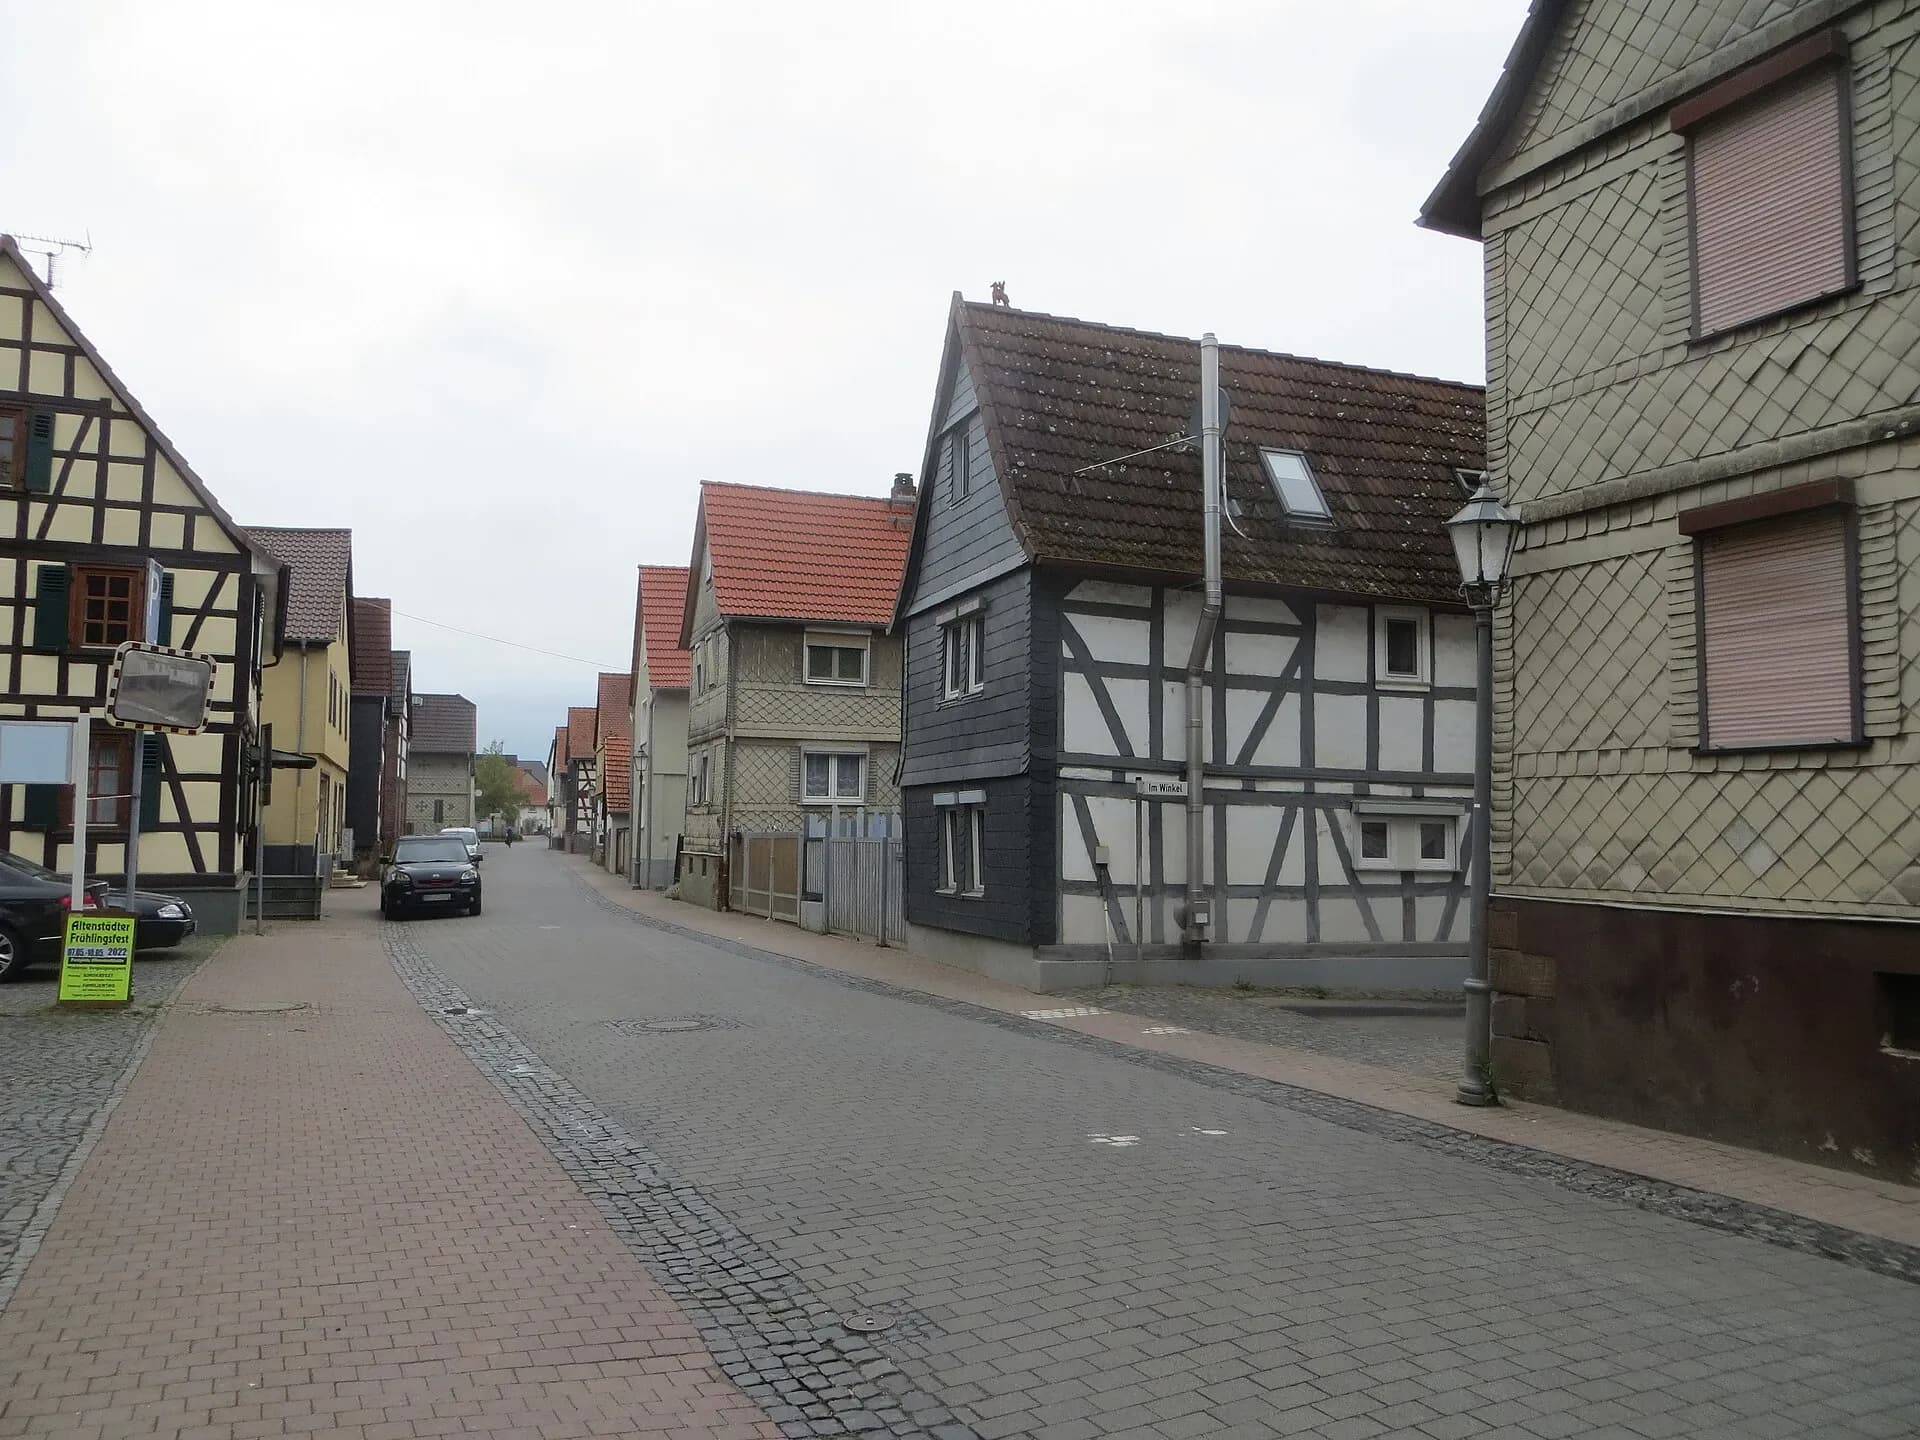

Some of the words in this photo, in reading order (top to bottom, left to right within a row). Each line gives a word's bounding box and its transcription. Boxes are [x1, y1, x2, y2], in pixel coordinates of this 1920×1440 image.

[149, 571, 160, 616] P
[1148, 784, 1158, 792] Im
[1160, 784, 1183, 792] Winkel
[71, 920, 130, 931] Altenstädter
[70, 933, 129, 945] Frühlingsfest
[107, 947, 127, 956] 2022
